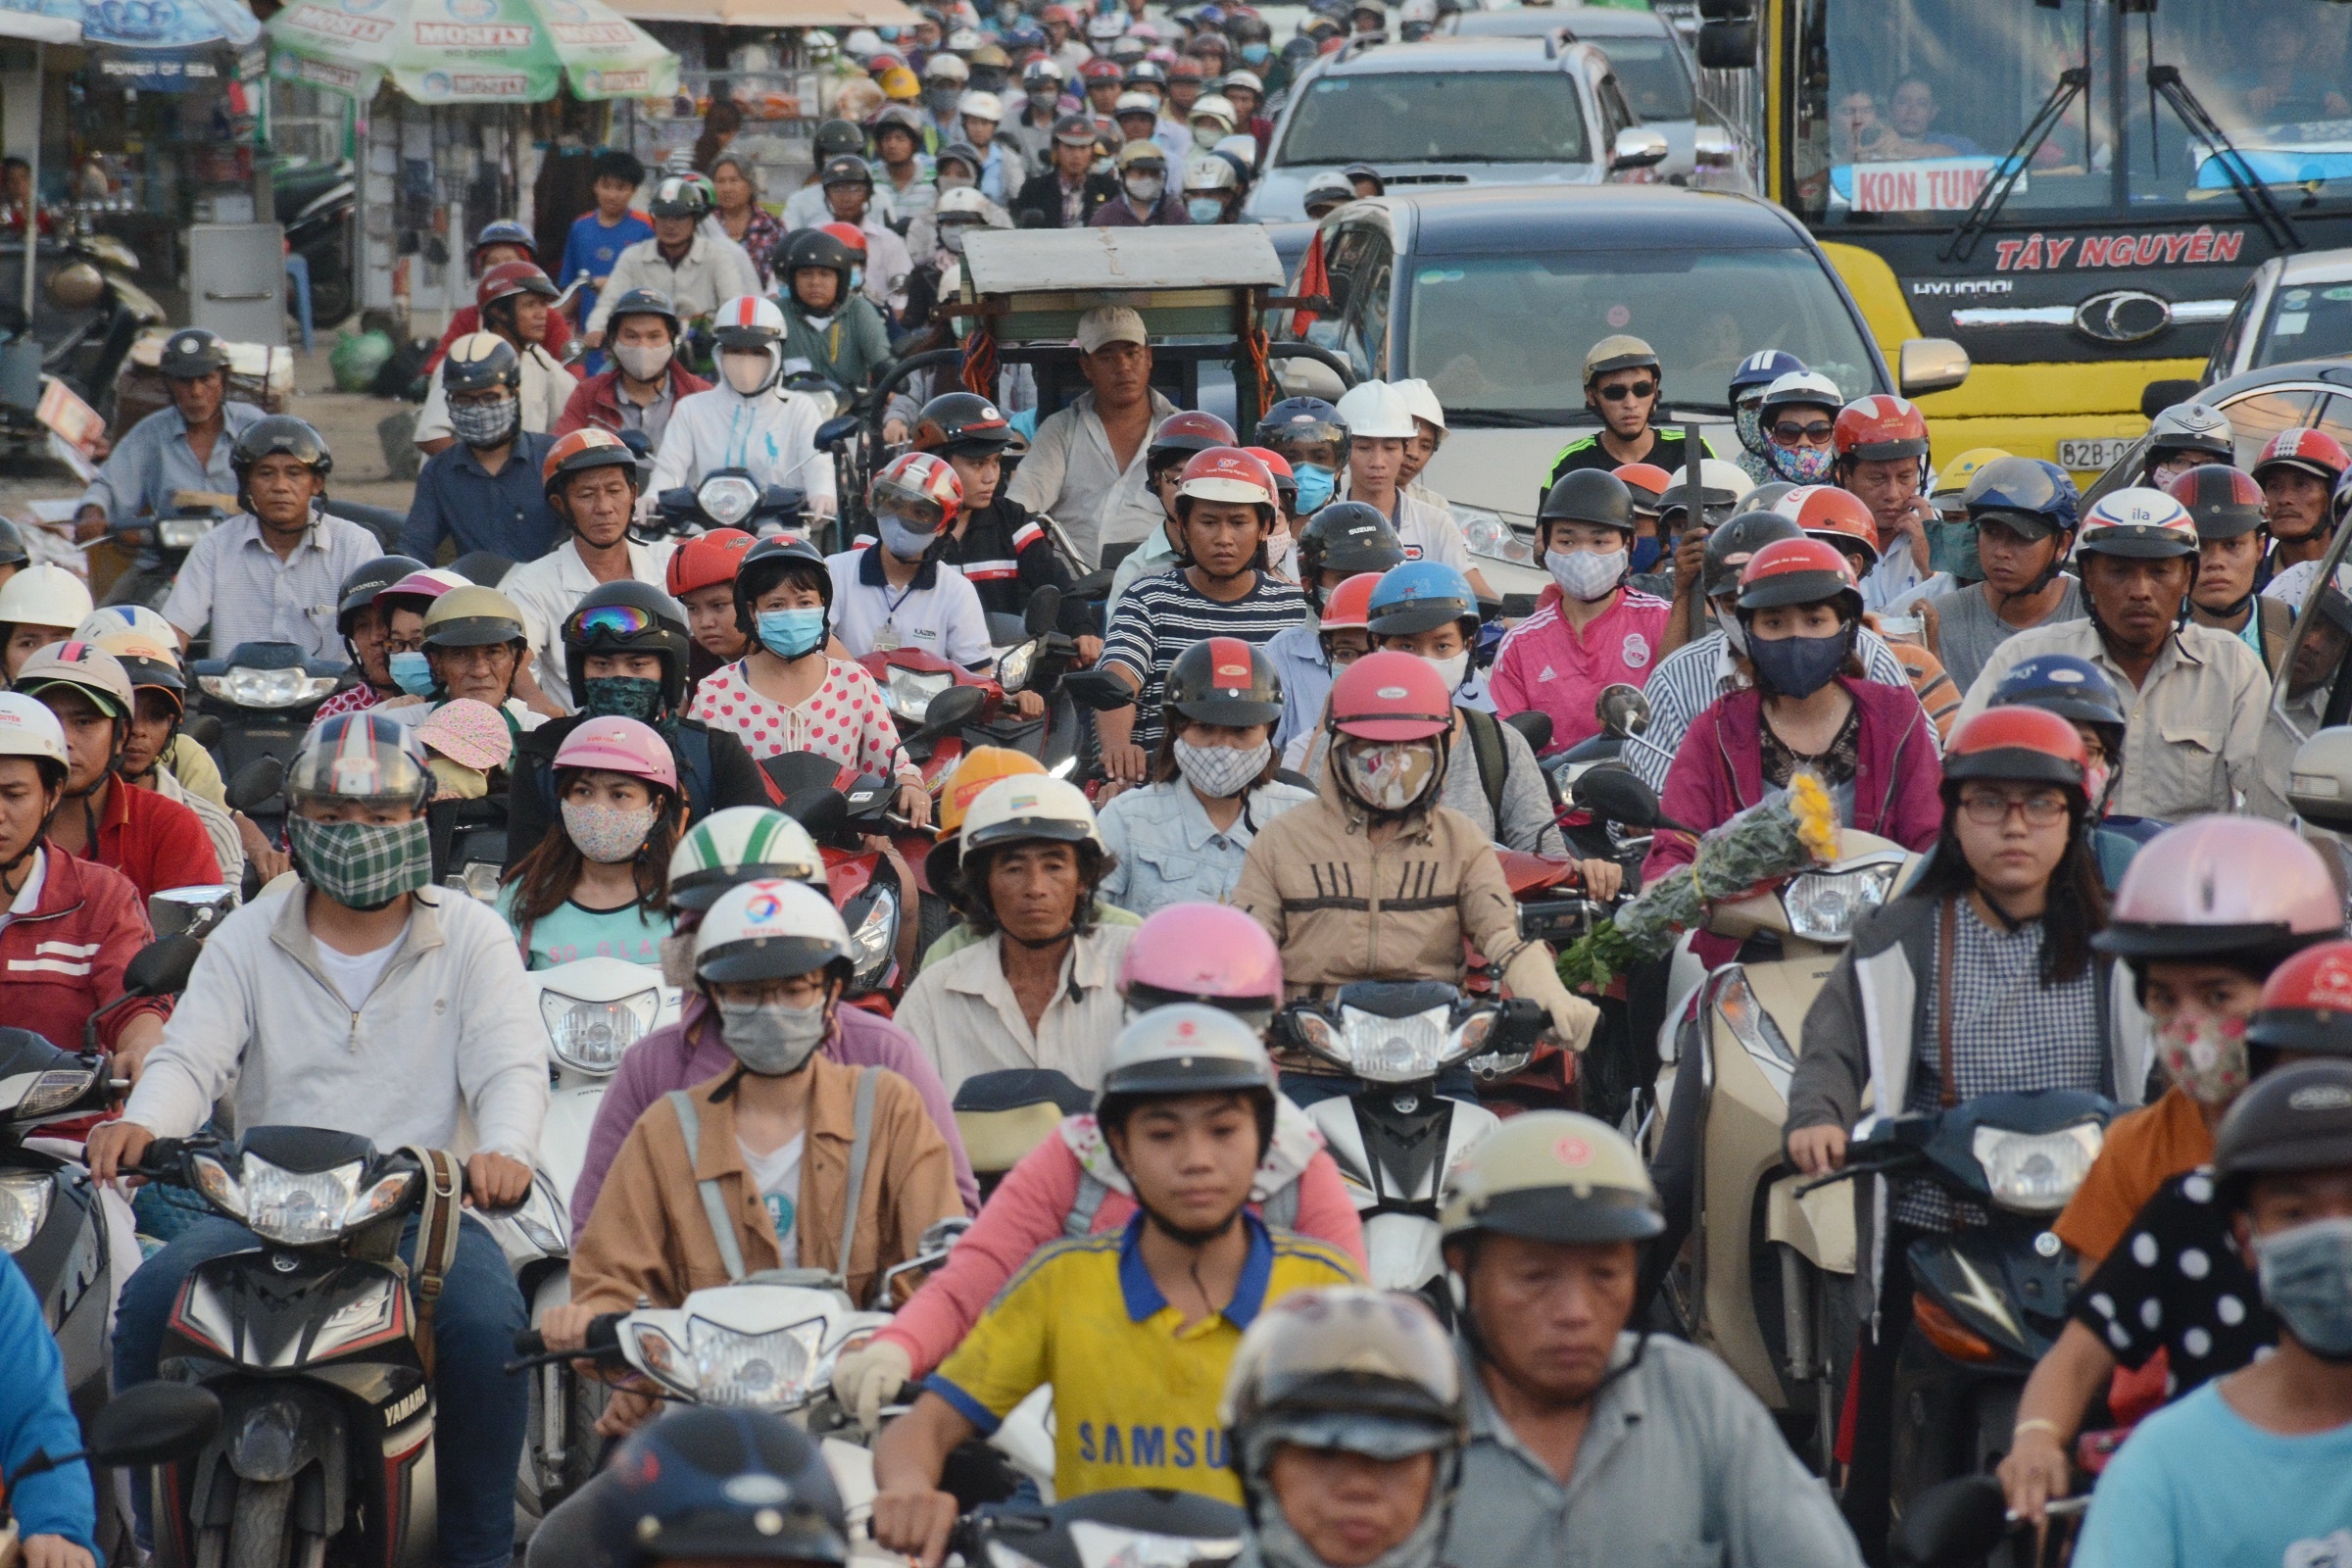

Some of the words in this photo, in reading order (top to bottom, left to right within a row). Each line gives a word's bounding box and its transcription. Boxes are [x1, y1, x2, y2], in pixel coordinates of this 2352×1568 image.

[420, 24, 526, 44] MOSFLY
[101, 62, 156, 75] POWER
[159, 62, 181, 75] OF
[184, 62, 219, 77] SEA
[455, 76, 525, 93] MOSFLY
[1859, 172, 1917, 212] KON
[1926, 170, 1989, 210] TUM
[1996, 233, 2075, 270] TÂY
[2076, 224, 2243, 268] NGUYÊN
[2063, 443, 2135, 466] 82B-0
[2132, 508, 2150, 520] ila
[1348, 525, 1377, 535] SUZUKI
[349, 580, 388, 595] HONDA
[549, 945, 577, 962] SO
[597, 937, 670, 958] GLA
[384, 1384, 427, 1427] YAMAHA
